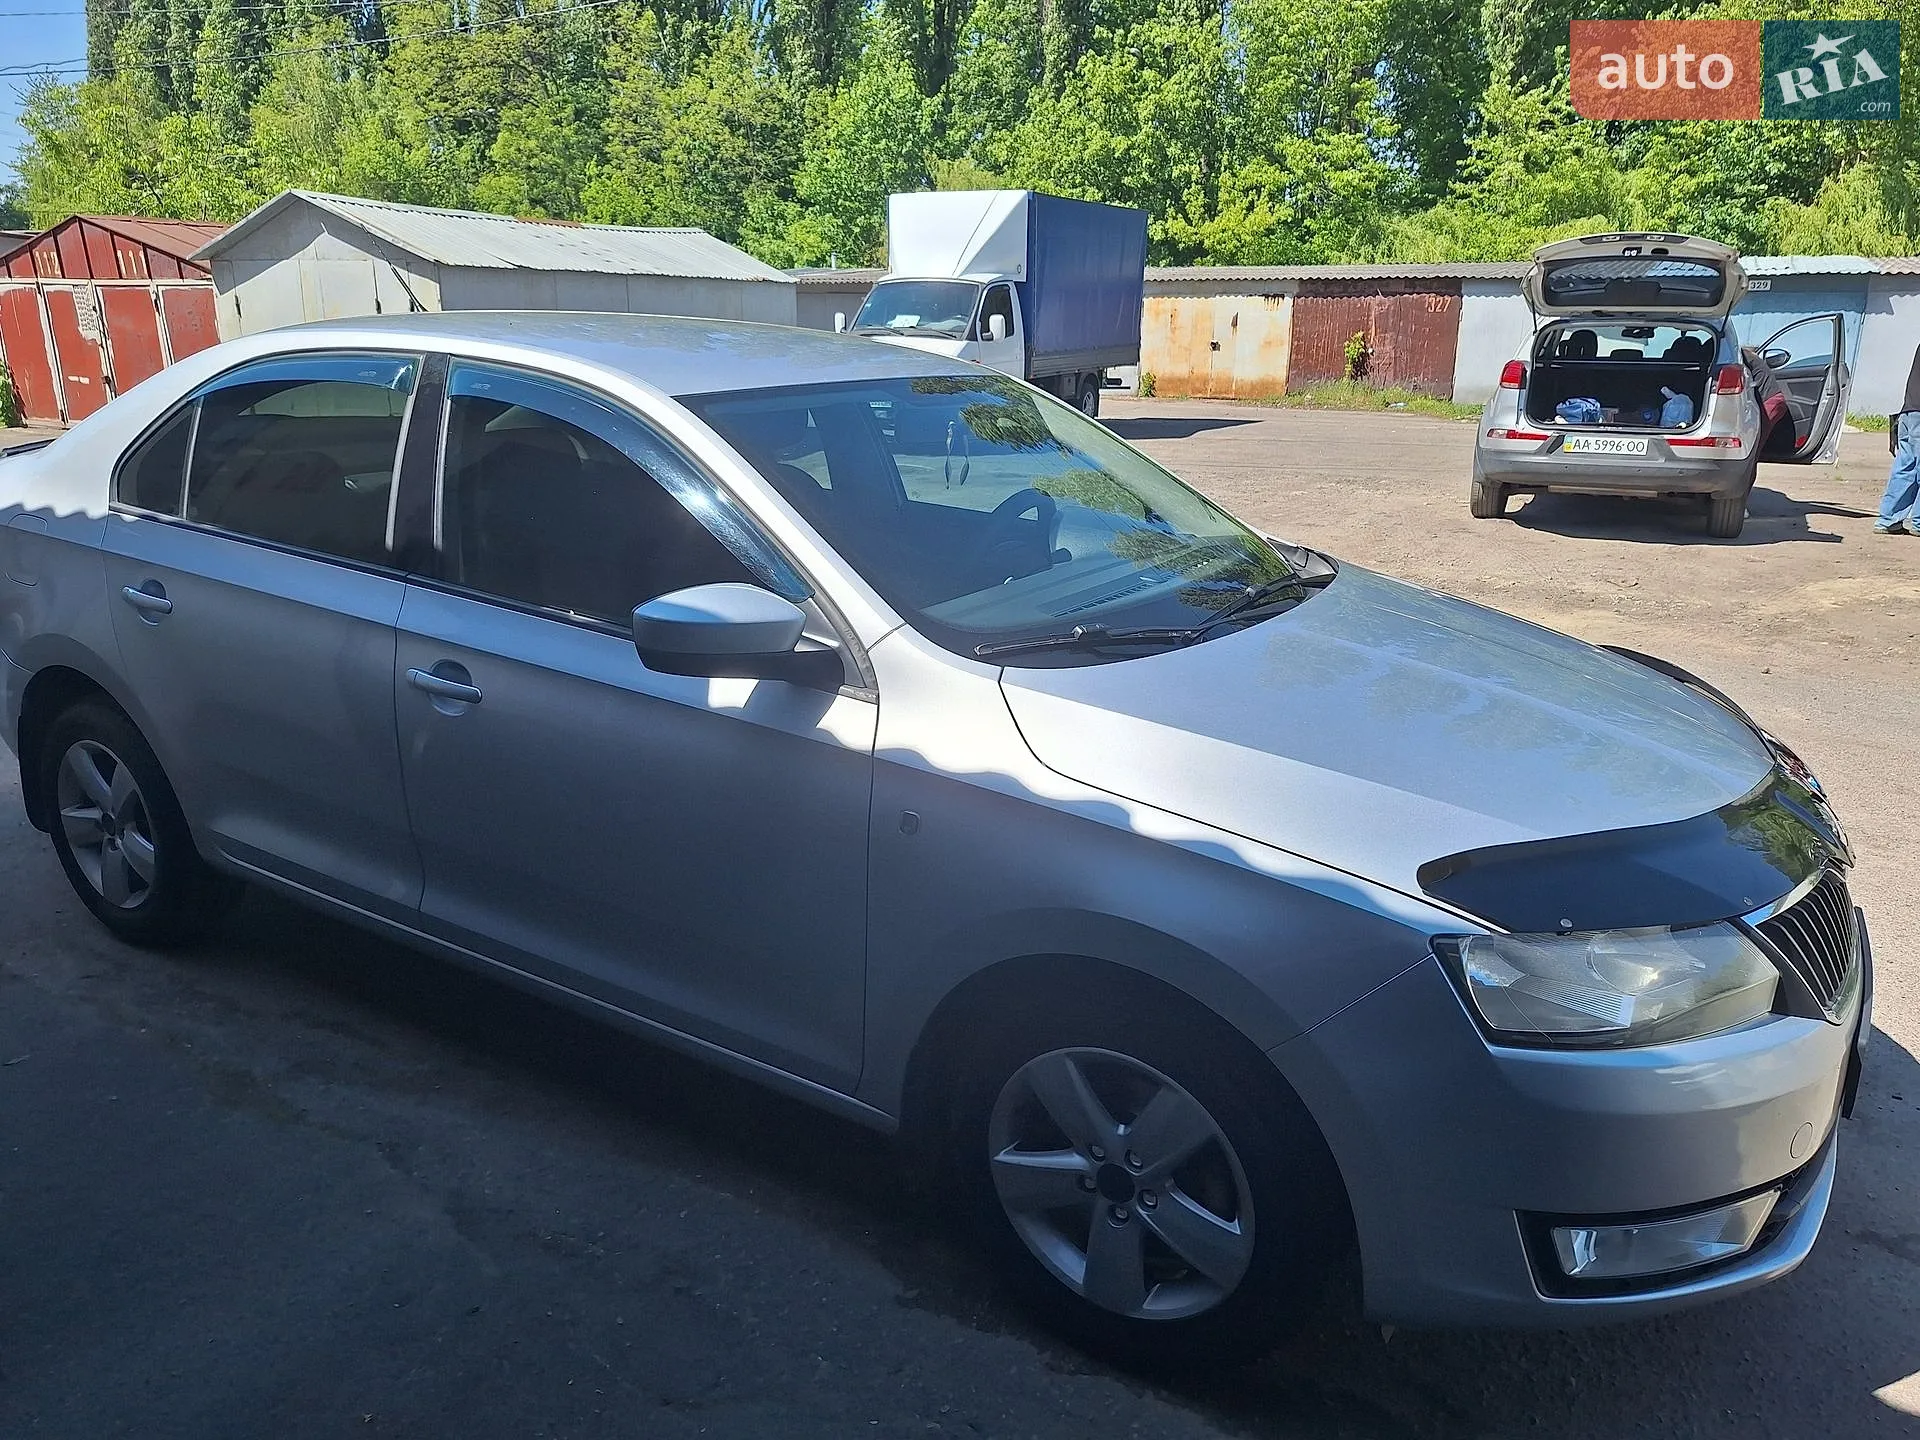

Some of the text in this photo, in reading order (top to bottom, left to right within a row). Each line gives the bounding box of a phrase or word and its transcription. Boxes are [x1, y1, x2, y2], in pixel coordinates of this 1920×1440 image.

[35, 251, 61, 276] 112
[117, 249, 148, 276] 111
[1750, 281, 1768, 289] 329
[1428, 296, 1451, 312] 327
[1572, 439, 1590, 451] AA
[1594, 440, 1622, 452] 5996
